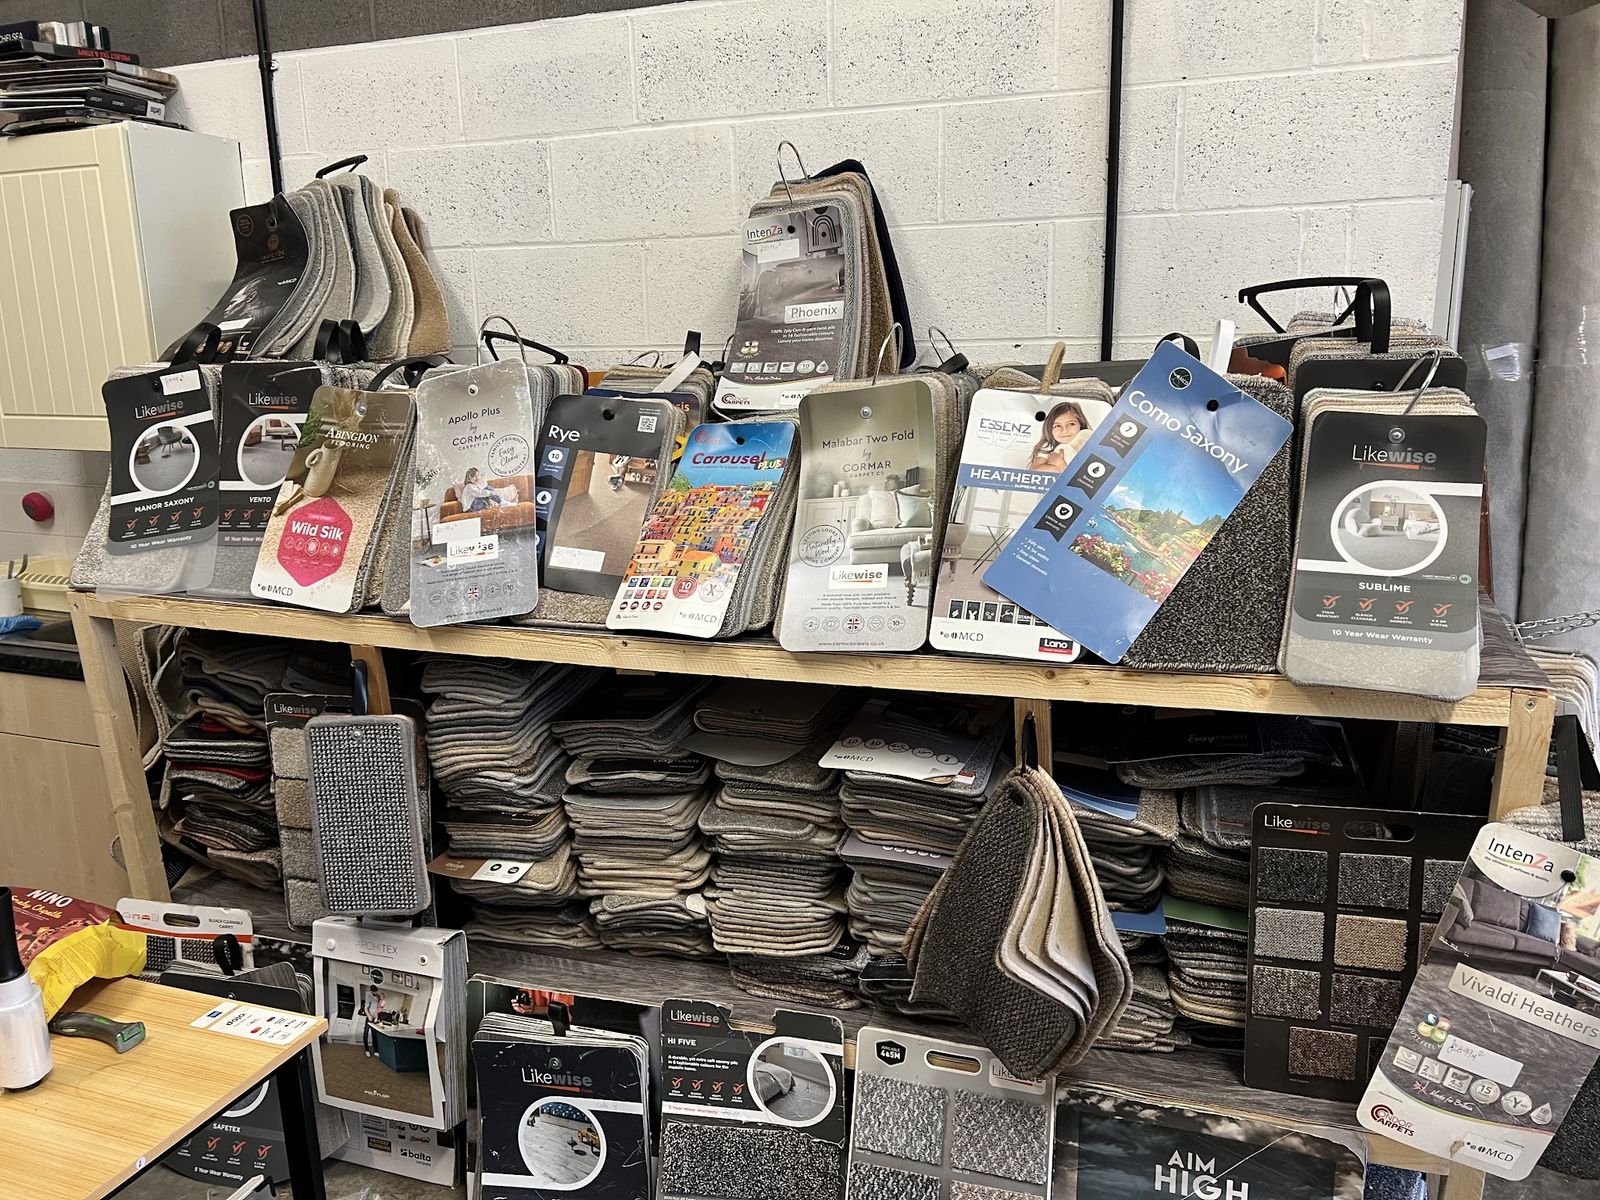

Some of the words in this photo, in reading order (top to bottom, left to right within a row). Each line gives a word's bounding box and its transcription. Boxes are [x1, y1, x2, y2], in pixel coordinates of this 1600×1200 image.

[746, 224, 783, 239] IntenZa
[791, 304, 838, 319] Phoenix
[248, 392, 298, 405] Likewise
[135, 399, 184, 419] Likewise
[448, 411, 479, 425] Apollo
[481, 407, 501, 417] Plus
[979, 417, 1032, 435] ESSENZ
[1128, 389, 1181, 433] Como
[1179, 424, 1249, 474] Saxony
[324, 426, 380, 444] ABINGDON
[452, 431, 496, 446] CORMAR
[548, 425, 581, 443] Rye
[822, 436, 864, 450] Malabar
[866, 434, 888, 446] Two
[891, 429, 915, 442] Fold
[330, 440, 371, 450] FLOORING
[692, 451, 767, 465] Carousel
[757, 459, 782, 470] PLUS
[1352, 445, 1438, 464] Likewise
[842, 460, 892, 473] CORMAR
[134, 502, 163, 513] MANOR
[163, 496, 195, 508] SAXONY
[290, 520, 318, 537] Wild
[321, 525, 344, 541] Silk
[832, 569, 883, 581] Likewise
[272, 585, 294, 597] MCD
[680, 581, 692, 590] 10
[1358, 581, 1412, 593] SUBLIME
[958, 631, 984, 642] MCD
[1043, 638, 1068, 649] Lano
[1344, 630, 1364, 638] Year
[1365, 631, 1389, 640] Wear
[1391, 634, 1434, 645] Warranty
[273, 703, 317, 715] Likewise
[1264, 814, 1331, 830] Likewise
[1488, 837, 1554, 873] IntenZa
[26, 889, 74, 908] NINO
[356, 940, 398, 955] ARCHITEX
[1461, 971, 1518, 1007] Vivaldi
[1519, 996, 1599, 1038] Heathers
[670, 1009, 720, 1024] Likewise
[667, 1037, 676, 1045] HI
[677, 1038, 697, 1047] FIVE
[521, 1067, 593, 1088] Likewise
[992, 1064, 1043, 1084] Likee
[1479, 1084, 1492, 1095] 15
[212, 1122, 241, 1133] SAFETEX
[408, 1148, 432, 1162] balta
[1167, 1149, 1216, 1174] AIM
[1486, 1147, 1514, 1163] MCD
[198, 1167, 209, 1175] Year
[209, 1169, 223, 1177] Wear
[222, 1170, 244, 1181] Warranty
[1154, 1163, 1249, 1200] HIGH
